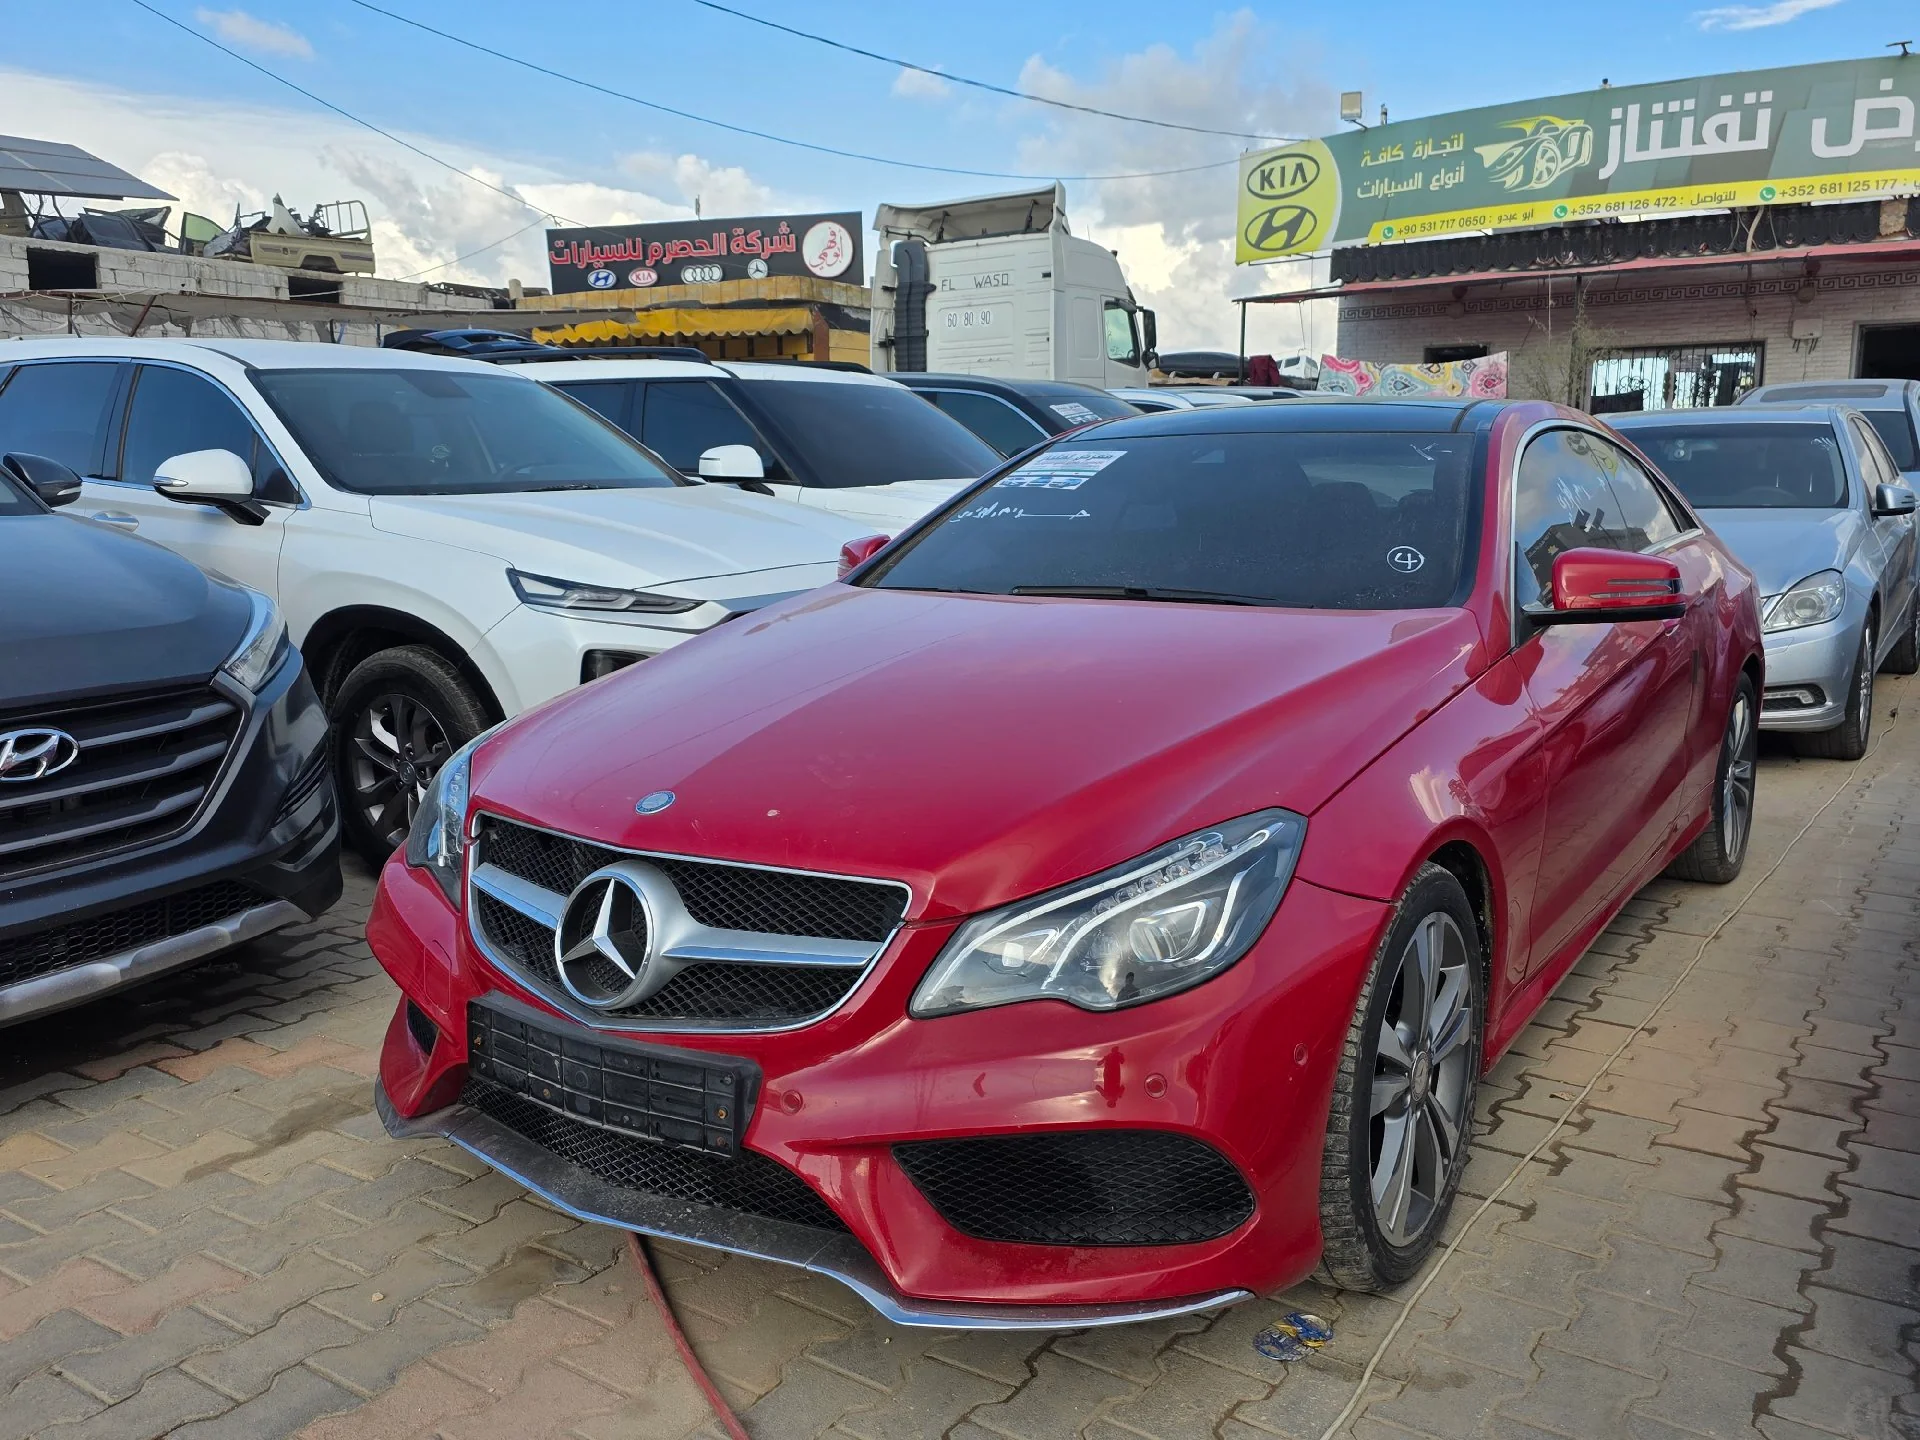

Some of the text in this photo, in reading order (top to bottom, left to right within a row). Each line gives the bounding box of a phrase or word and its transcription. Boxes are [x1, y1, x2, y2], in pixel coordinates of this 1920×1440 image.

[1599, 90, 1773, 179] تفتناز
[1361, 132, 1464, 168] لتجارة كافة
[1259, 162, 1308, 191] KIA
[1357, 160, 1465, 199] أنواع السيارات
[1779, 178, 1898, 197] +352 681 125 177
[1571, 190, 1737, 216] للتواصل +352 681 126 472
[1397, 224, 1417, 236] +90
[1420, 221, 1436, 233] 531
[1440, 219, 1456, 230] 717
[1459, 215, 1486, 228] 0650
[549, 221, 796, 269] شركة الحصرم للسيارات
[635, 272, 653, 281] KIA
[947, 310, 991, 328] 60 80 90
[1394, 552, 1418, 569] 4
